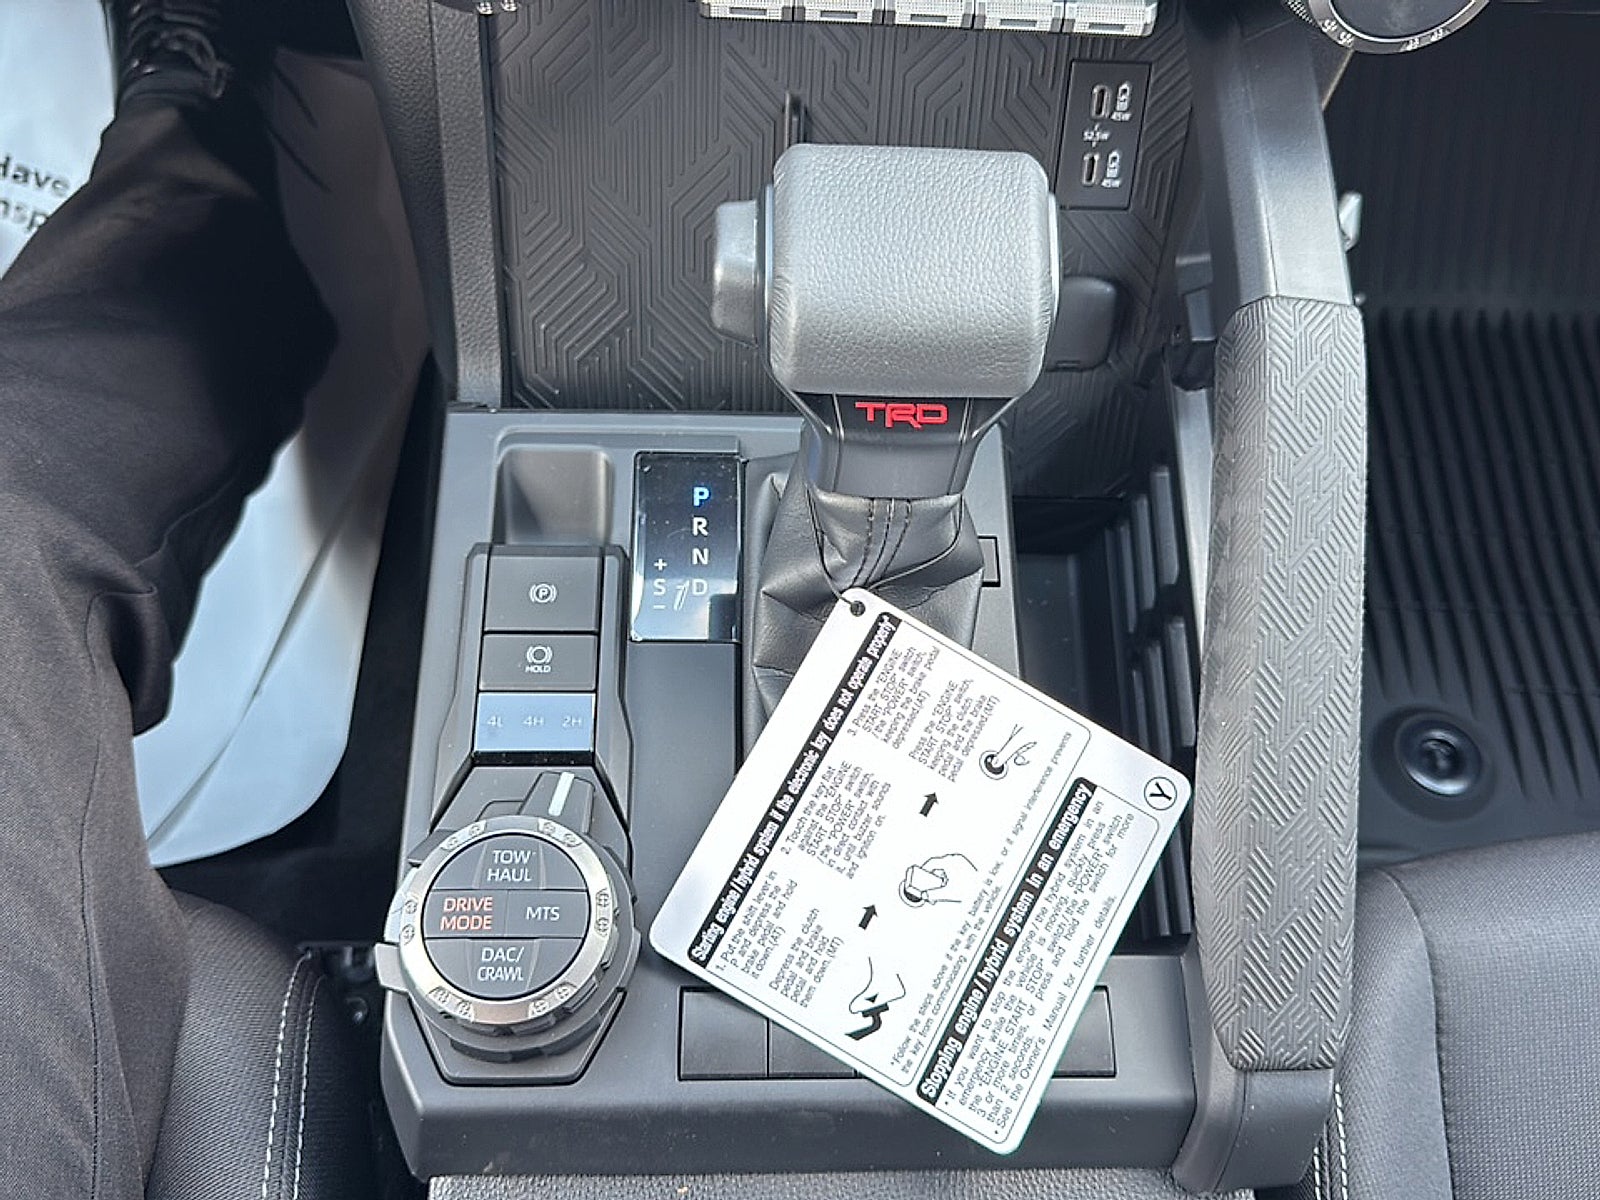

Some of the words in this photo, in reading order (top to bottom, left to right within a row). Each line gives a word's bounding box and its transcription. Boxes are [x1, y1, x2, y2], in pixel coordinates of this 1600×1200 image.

[855, 401, 948, 428] TRD
[692, 486, 711, 507] P
[692, 516, 709, 536] R
[692, 548, 709, 565] N
[653, 578, 667, 596] S
[692, 578, 708, 596] D
[525, 664, 552, 674] HOLD
[487, 714, 503, 728] 4L
[523, 714, 545, 728] 4H
[562, 714, 582, 728] 2H
[1150, 782, 1173, 803] Y
[691, 922, 725, 961] Starting
[753, 821, 780, 856] system
[775, 794, 795, 812] the
[787, 749, 820, 795] electronic
[809, 731, 832, 751] key
[822, 706, 844, 731] does
[837, 688, 855, 708] not
[847, 656, 873, 690] operate
[493, 850, 531, 865] TOW
[487, 868, 532, 882] HAUL
[443, 896, 493, 912] DRIVE
[525, 905, 561, 921] MTS
[440, 914, 493, 931] MODE
[920, 1036, 963, 1098] Stopping
[1003, 891, 1035, 938] system
[1037, 853, 1055, 872] an
[1048, 783, 1092, 850] emergency
[946, 1089, 957, 1100] If
[953, 1065, 970, 1088] you
[967, 1033, 985, 1060] want
[981, 1018, 993, 1030] to
[990, 991, 1007, 1015] stop
[1002, 969, 1017, 987] the
[1044, 871, 1067, 904] hybrid
[1063, 833, 1087, 869] system
[1092, 800, 1105, 815] an
[481, 946, 525, 963] DAC/
[958, 1047, 992, 1106] emergency
[988, 1016, 1007, 1043] while
[1003, 994, 1018, 1012] the
[1015, 953, 1038, 988] vehicle
[1066, 853, 1092, 890] quickly
[1086, 821, 1106, 851] press
[968, 1094, 983, 1113] the
[1004, 998, 1028, 1037] START
[1102, 814, 1123, 845] switch
[477, 965, 524, 981] CRAWL
[976, 1108, 987, 1118] 3
[992, 1060, 1010, 1088] more
[1034, 971, 1054, 1002] press
[1051, 945, 1067, 968] and
[1062, 917, 1080, 942] hold
[1075, 898, 1090, 916] the
[1088, 862, 1110, 894] switch
[1104, 843, 1118, 858] for
[1116, 813, 1135, 840] more
[995, 1106, 1013, 1130] See
[1009, 1083, 1024, 1102] the
[1019, 1036, 1046, 1080] Owner's
[1042, 991, 1067, 1032] Manual
[1063, 973, 1076, 988] for
[1073, 933, 1095, 968] further
[986, 1098, 1004, 1123] than
[1000, 1083, 1011, 1095] 2
